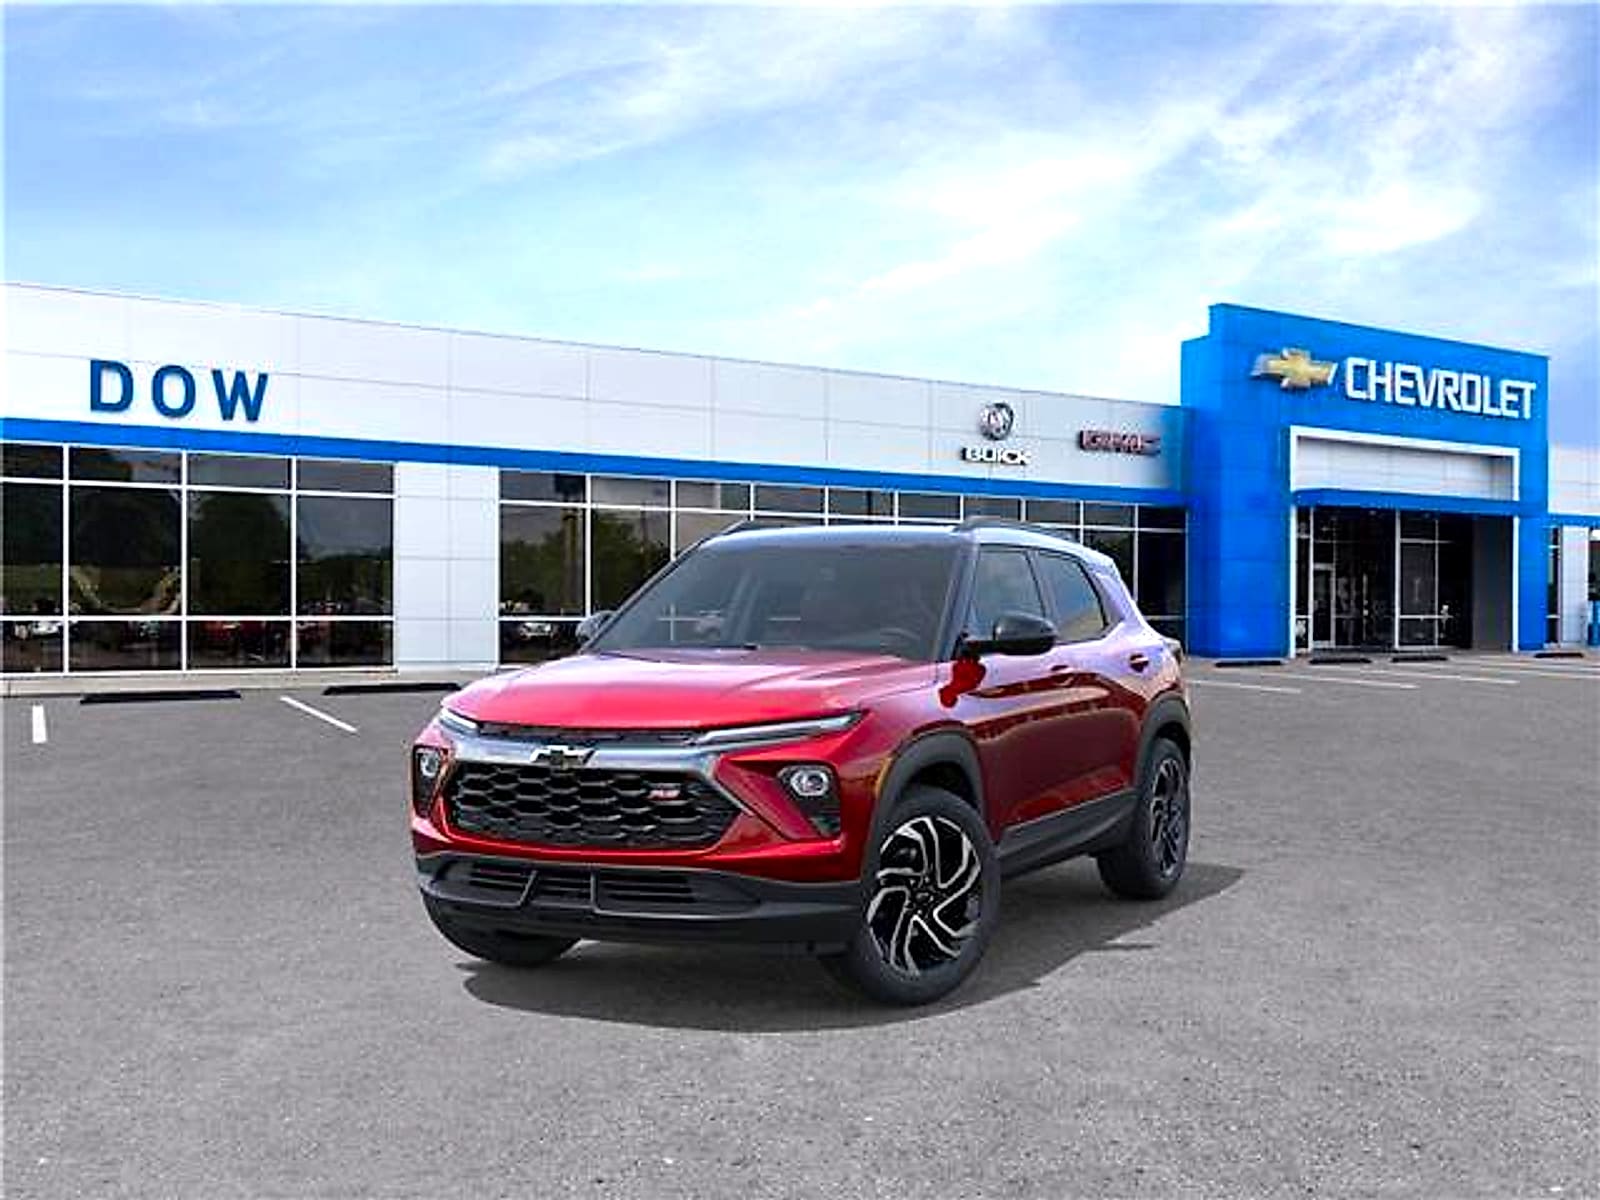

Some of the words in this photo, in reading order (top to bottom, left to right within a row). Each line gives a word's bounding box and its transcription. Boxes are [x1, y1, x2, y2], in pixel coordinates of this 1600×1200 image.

[90, 359, 268, 421] DOW
[1344, 356, 1537, 419] CHEVROLET
[963, 447, 1032, 465] BUICK
